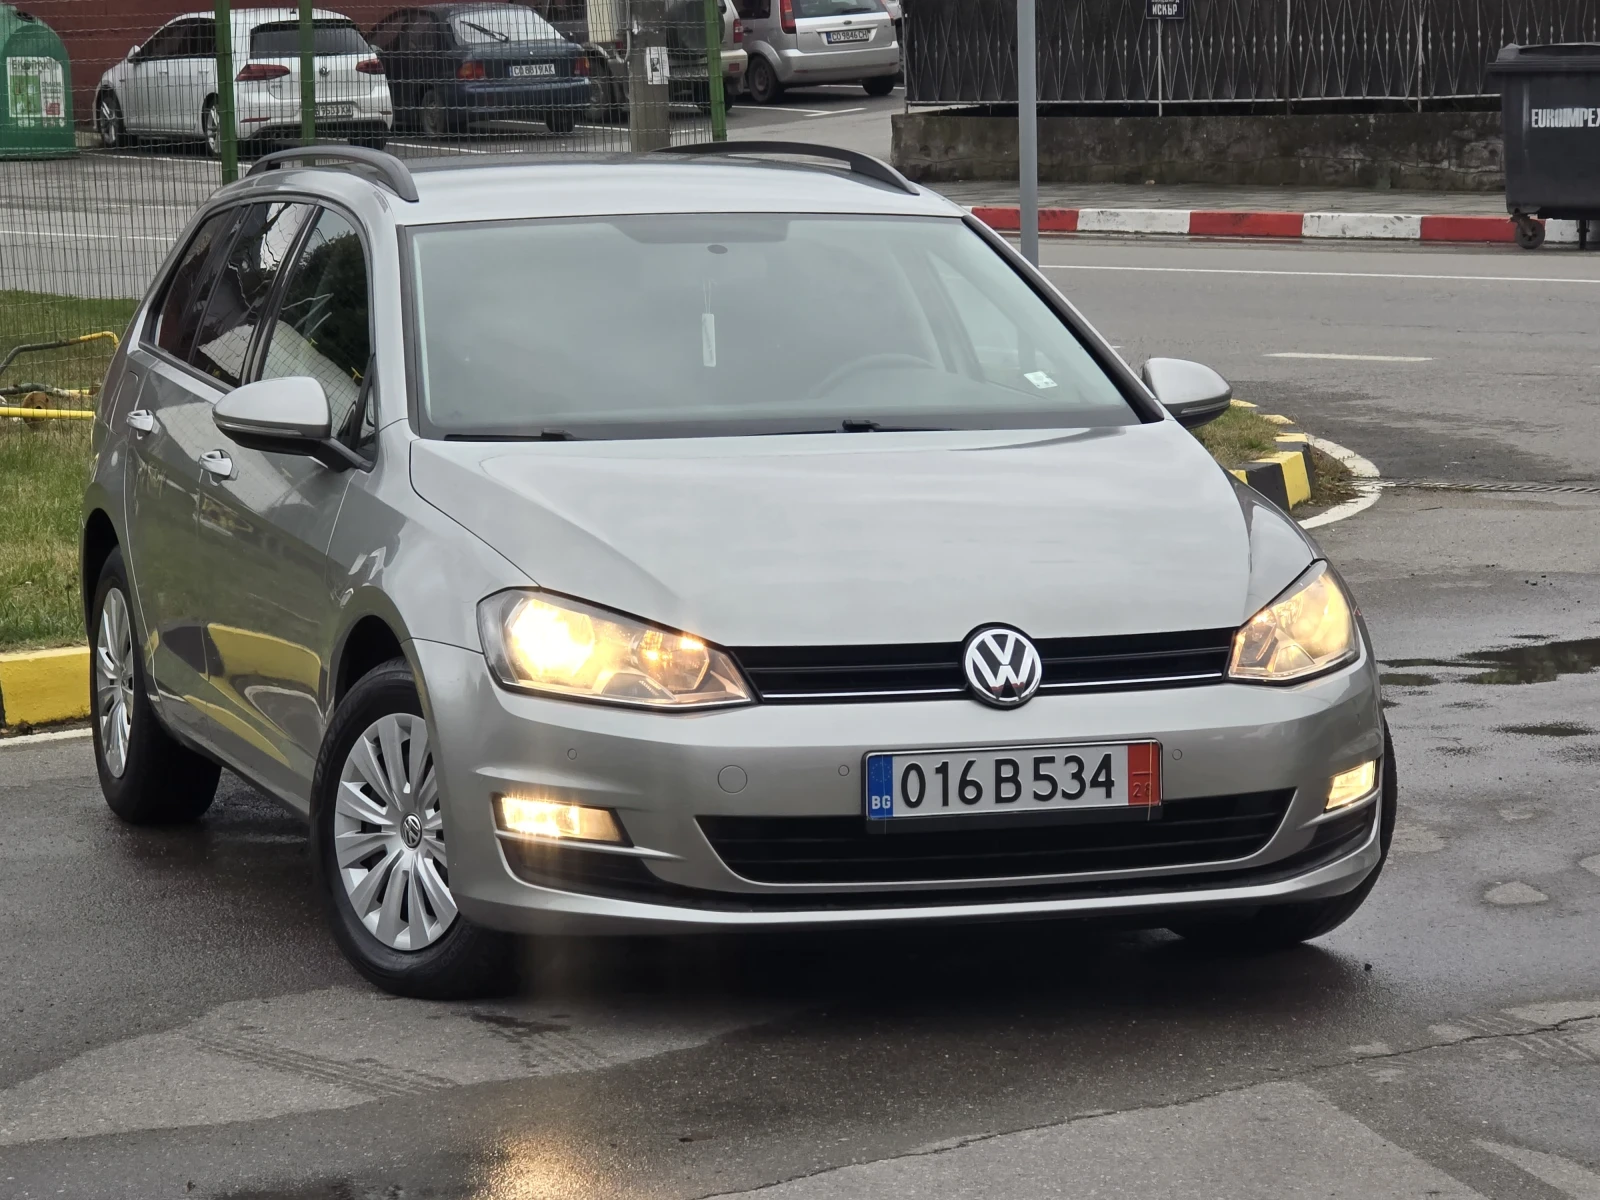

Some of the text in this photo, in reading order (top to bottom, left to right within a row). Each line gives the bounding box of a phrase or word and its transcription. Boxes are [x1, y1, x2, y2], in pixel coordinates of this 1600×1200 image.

[1152, 4, 1178, 15] ИСКЪР
[965, 629, 1042, 705] VW
[871, 795, 891, 810] BG
